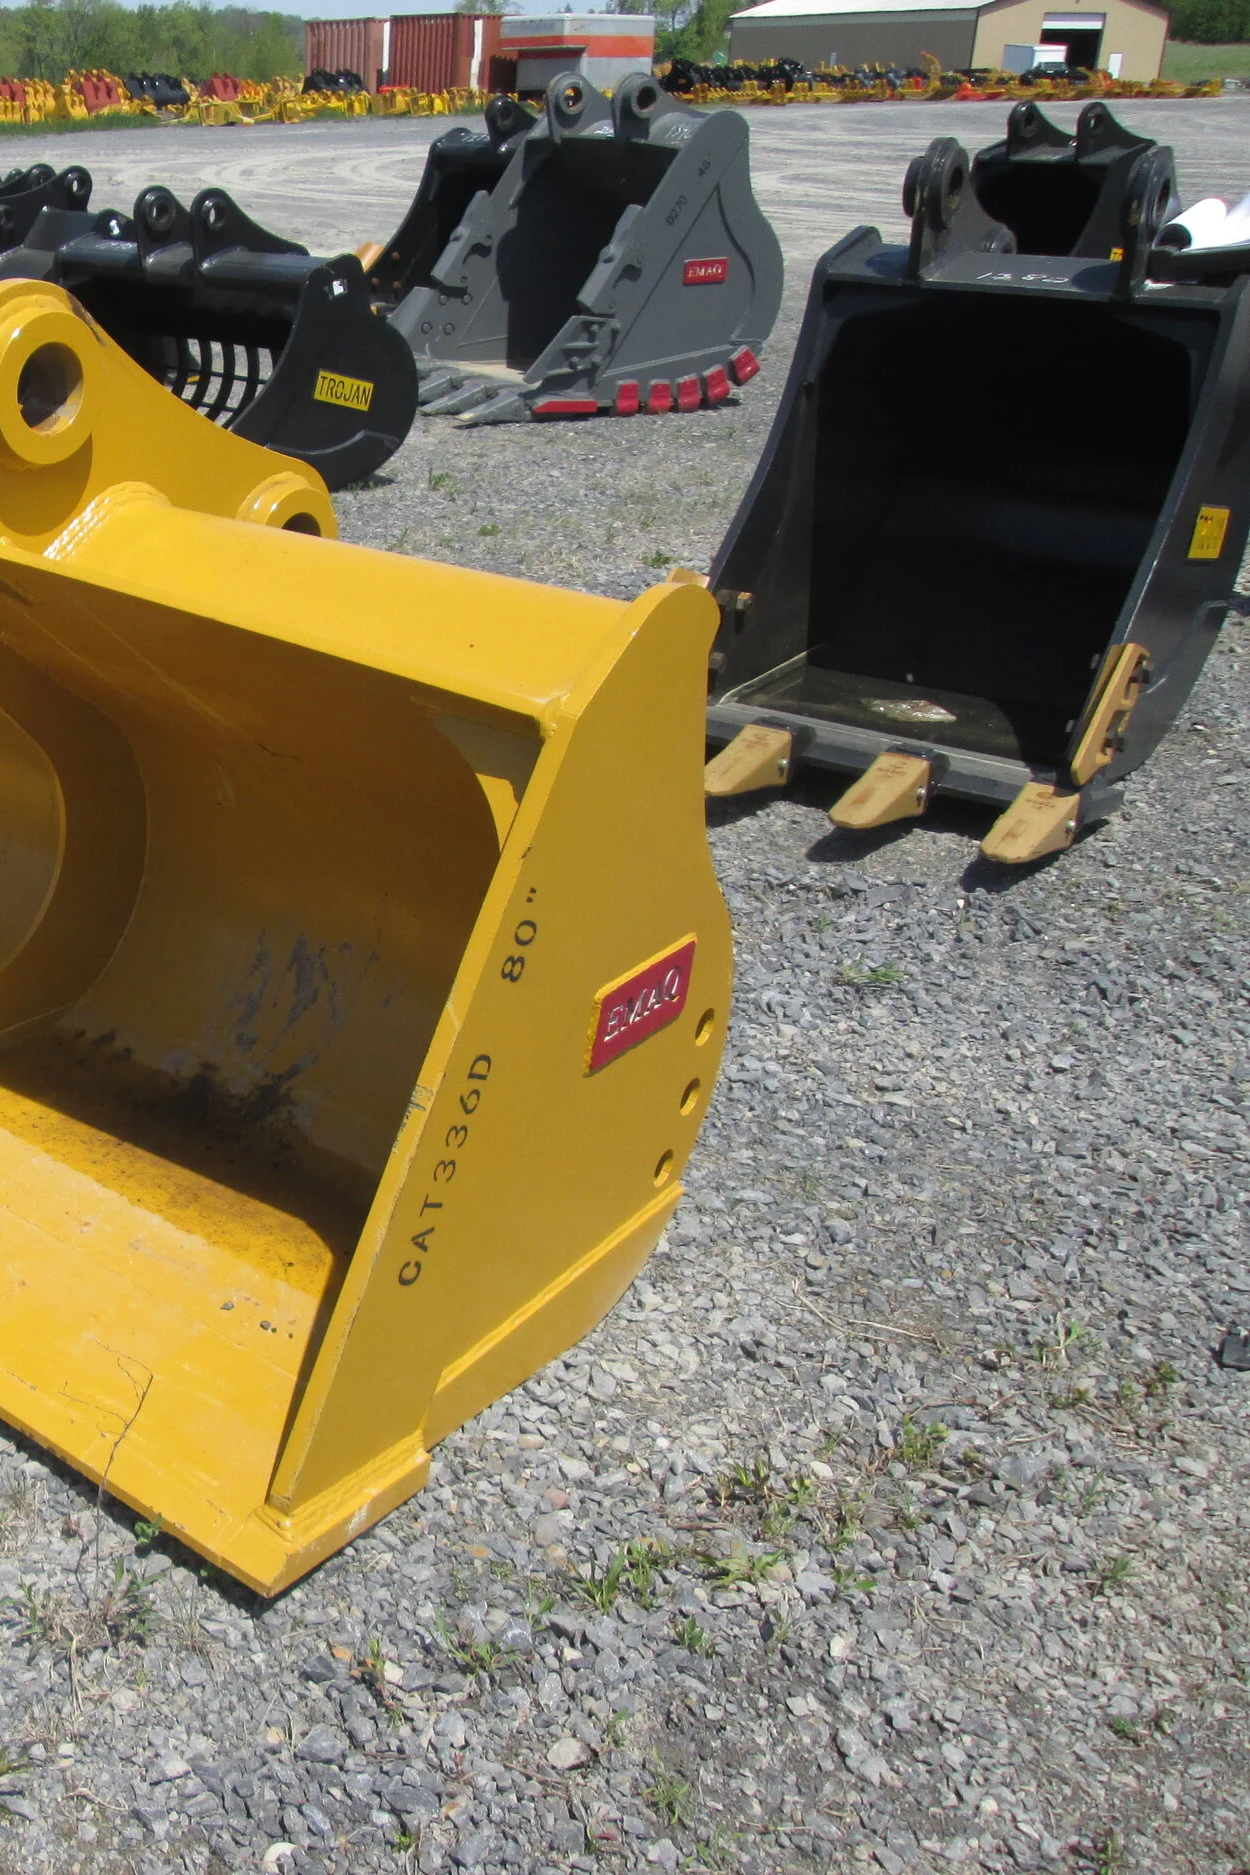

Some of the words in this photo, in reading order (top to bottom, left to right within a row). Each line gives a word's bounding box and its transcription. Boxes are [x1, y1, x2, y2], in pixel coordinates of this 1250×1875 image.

[319, 375, 371, 406] TROJAN
[603, 965, 682, 1042] EMAQ
[397, 1052, 492, 1287] CAT336D
[501, 887, 538, 983] 80"
